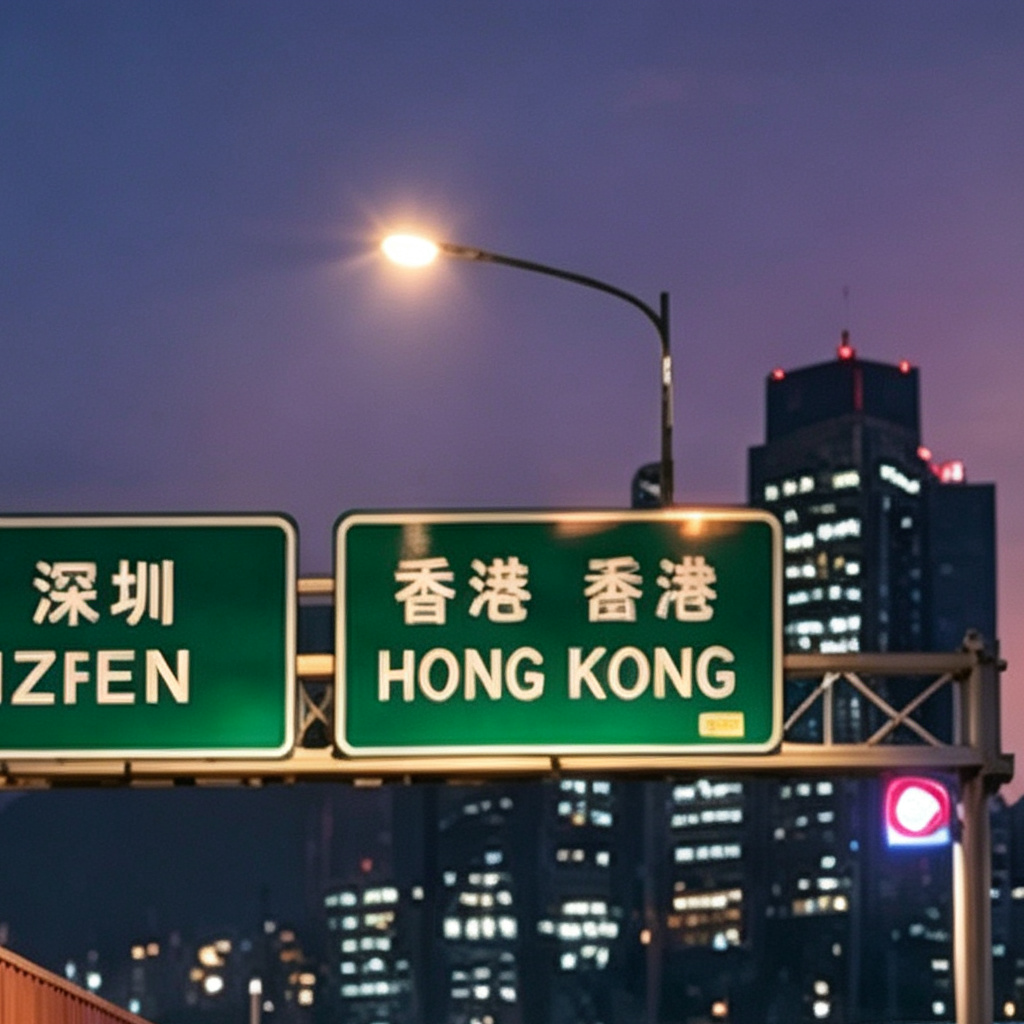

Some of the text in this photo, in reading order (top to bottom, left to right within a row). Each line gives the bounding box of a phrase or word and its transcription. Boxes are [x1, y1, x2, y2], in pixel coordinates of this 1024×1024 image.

[33, 560, 174, 626] 深圳
[394, 556, 718, 625] 香港 香港
[378, 645, 736, 702] HONG KONG
